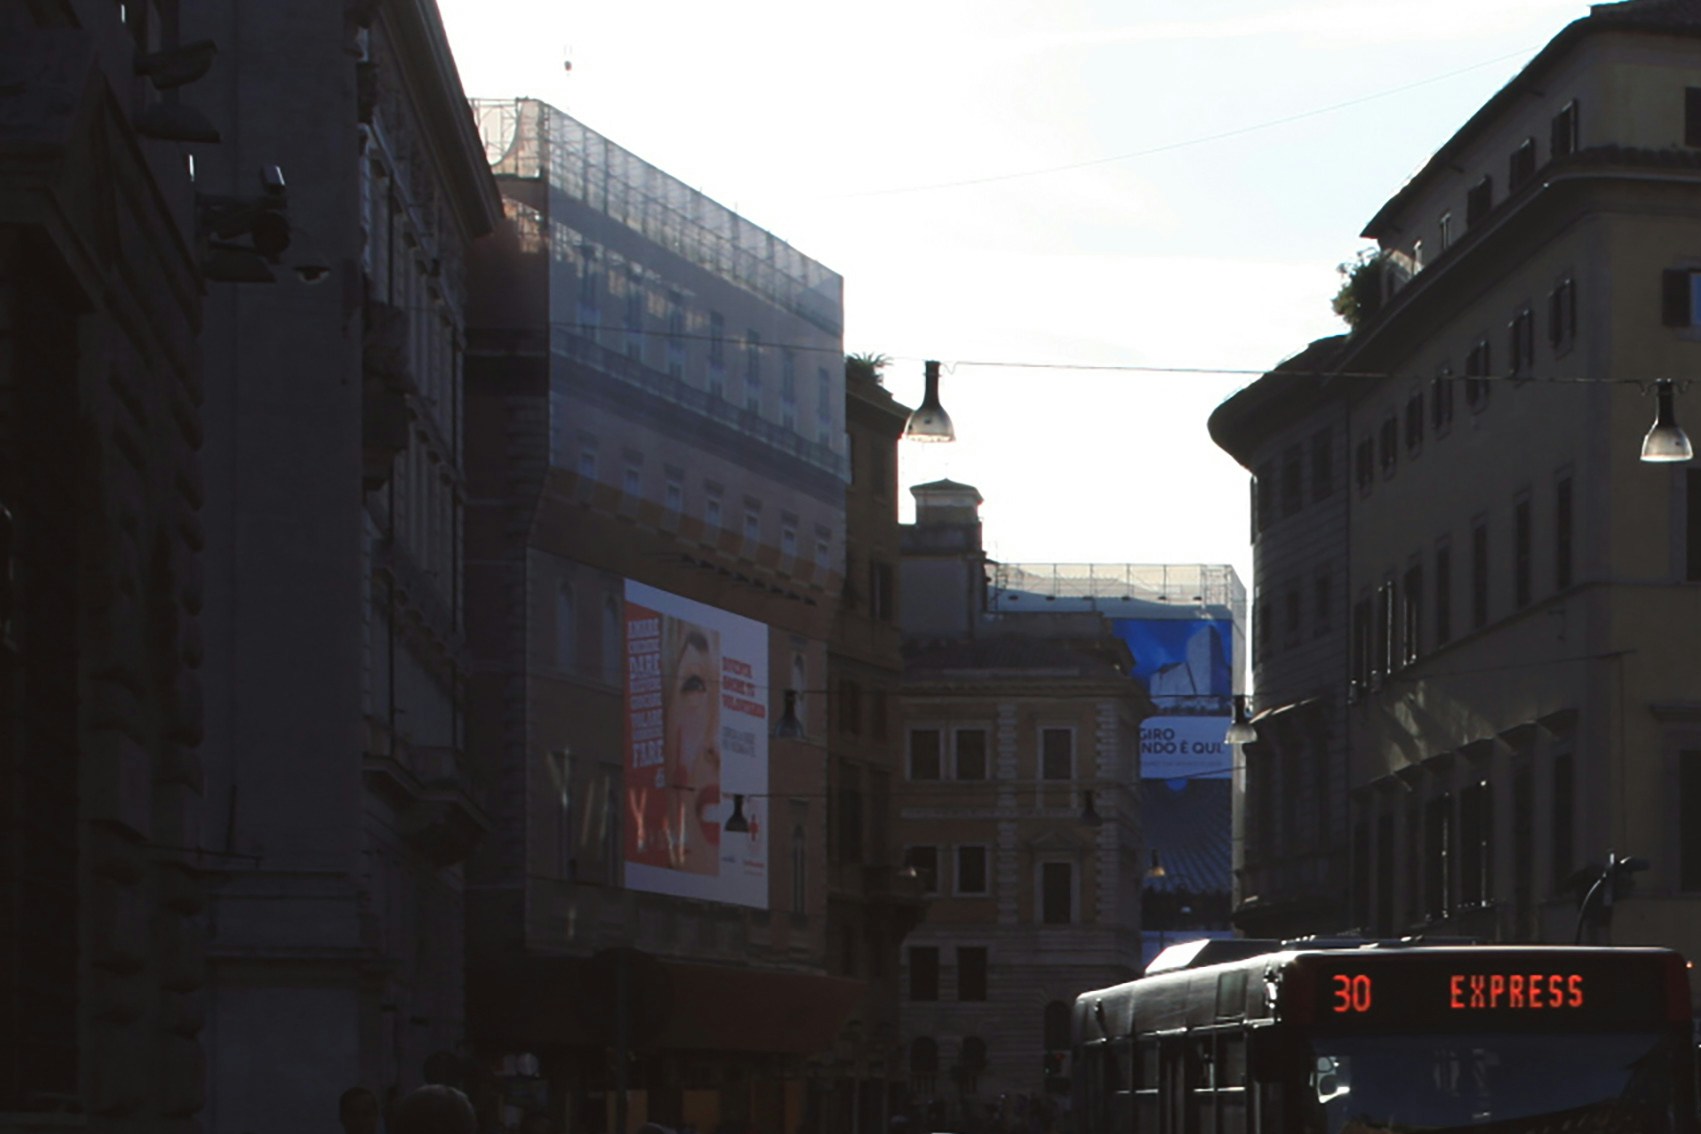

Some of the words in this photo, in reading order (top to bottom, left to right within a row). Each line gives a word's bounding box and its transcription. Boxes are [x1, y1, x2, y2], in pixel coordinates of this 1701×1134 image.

[632, 739, 664, 768] FARE
[1331, 973, 1372, 1013] 30
[1450, 974, 1584, 1008] EXPRESS
